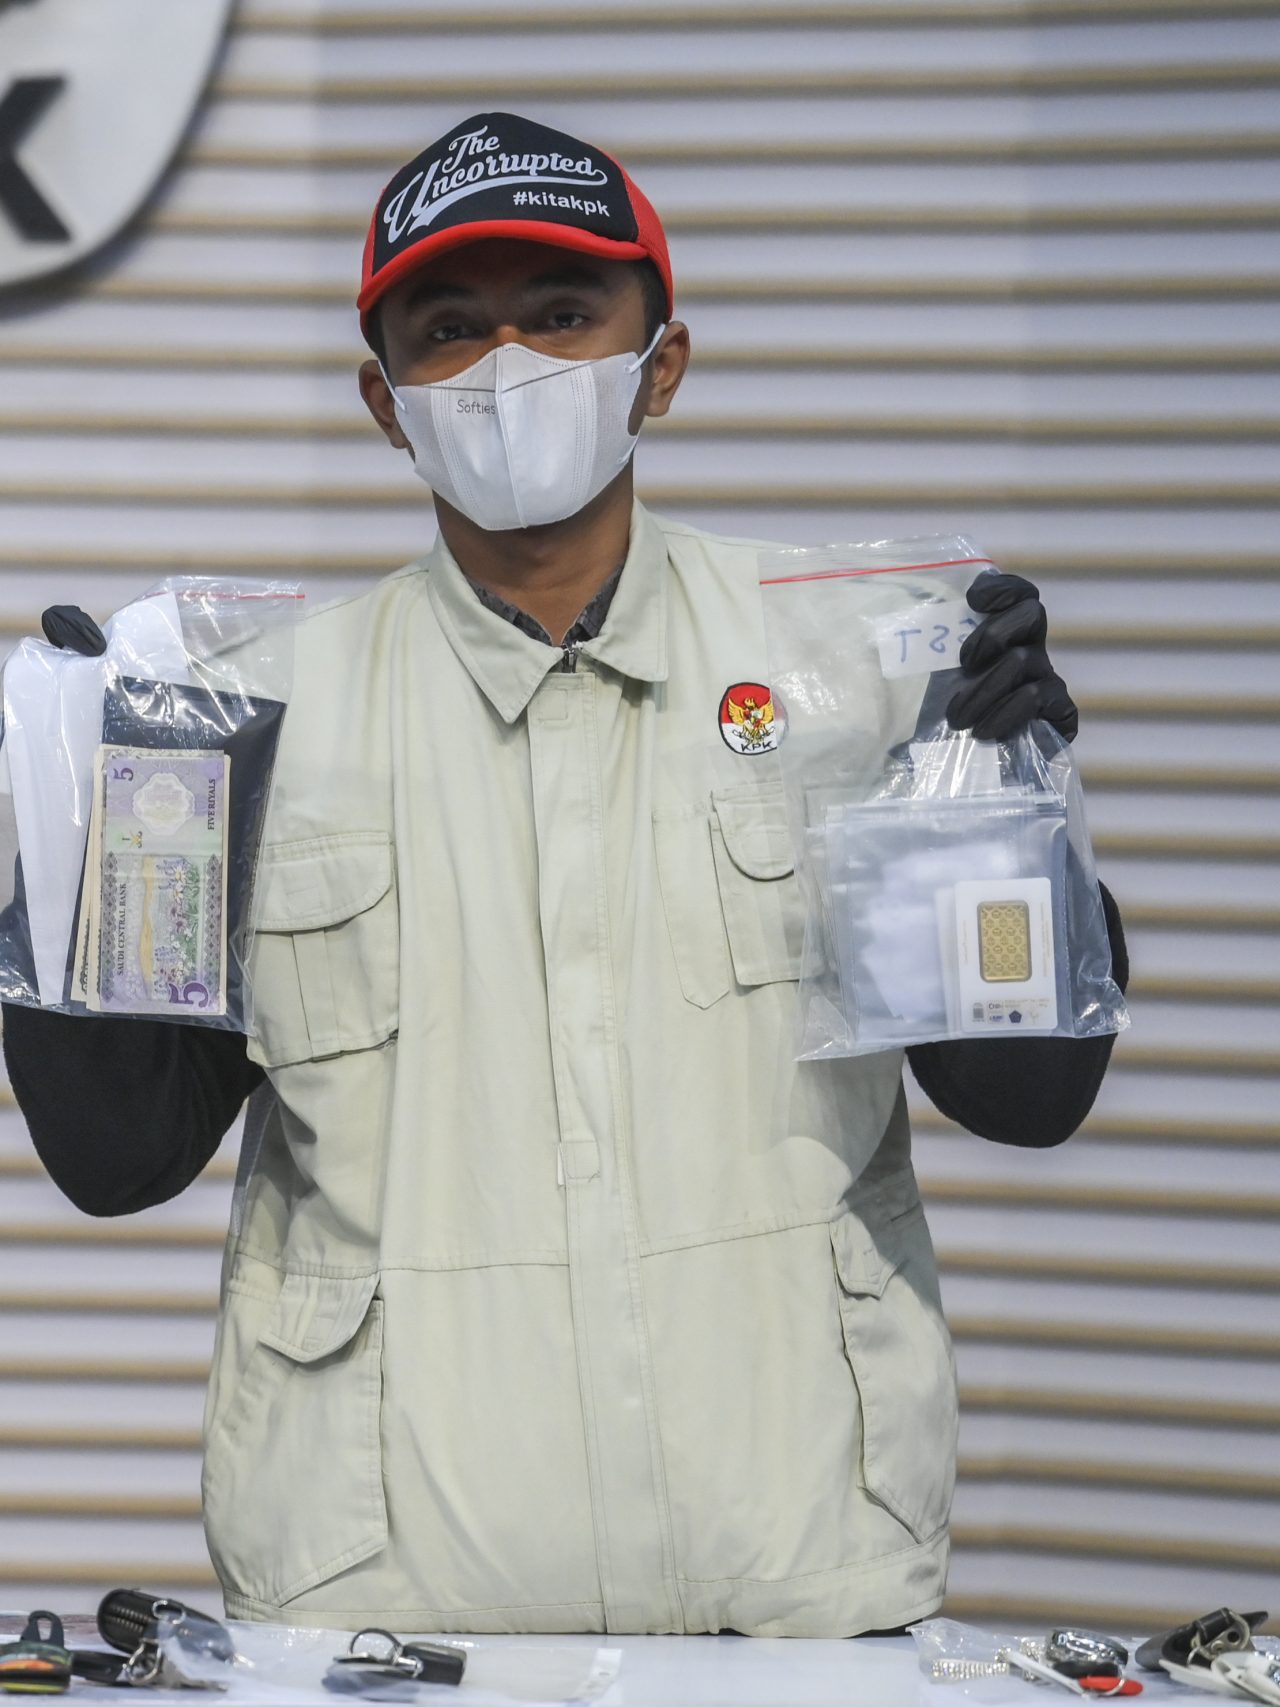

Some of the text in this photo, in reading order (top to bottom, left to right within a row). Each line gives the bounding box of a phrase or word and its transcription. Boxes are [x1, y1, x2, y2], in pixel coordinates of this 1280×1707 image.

[442, 125, 500, 173] The
[383, 152, 608, 243] Uncorrupted
[512, 191, 611, 217] #kitakpk
[456, 399, 496, 415] Softies
[741, 740, 773, 752] KPK
[113, 768, 133, 781] 5
[208, 779, 216, 809] RIYALS
[118, 910, 126, 948] CENTRAL
[117, 950, 125, 975] SAUDI
[169, 982, 209, 1008] 5
